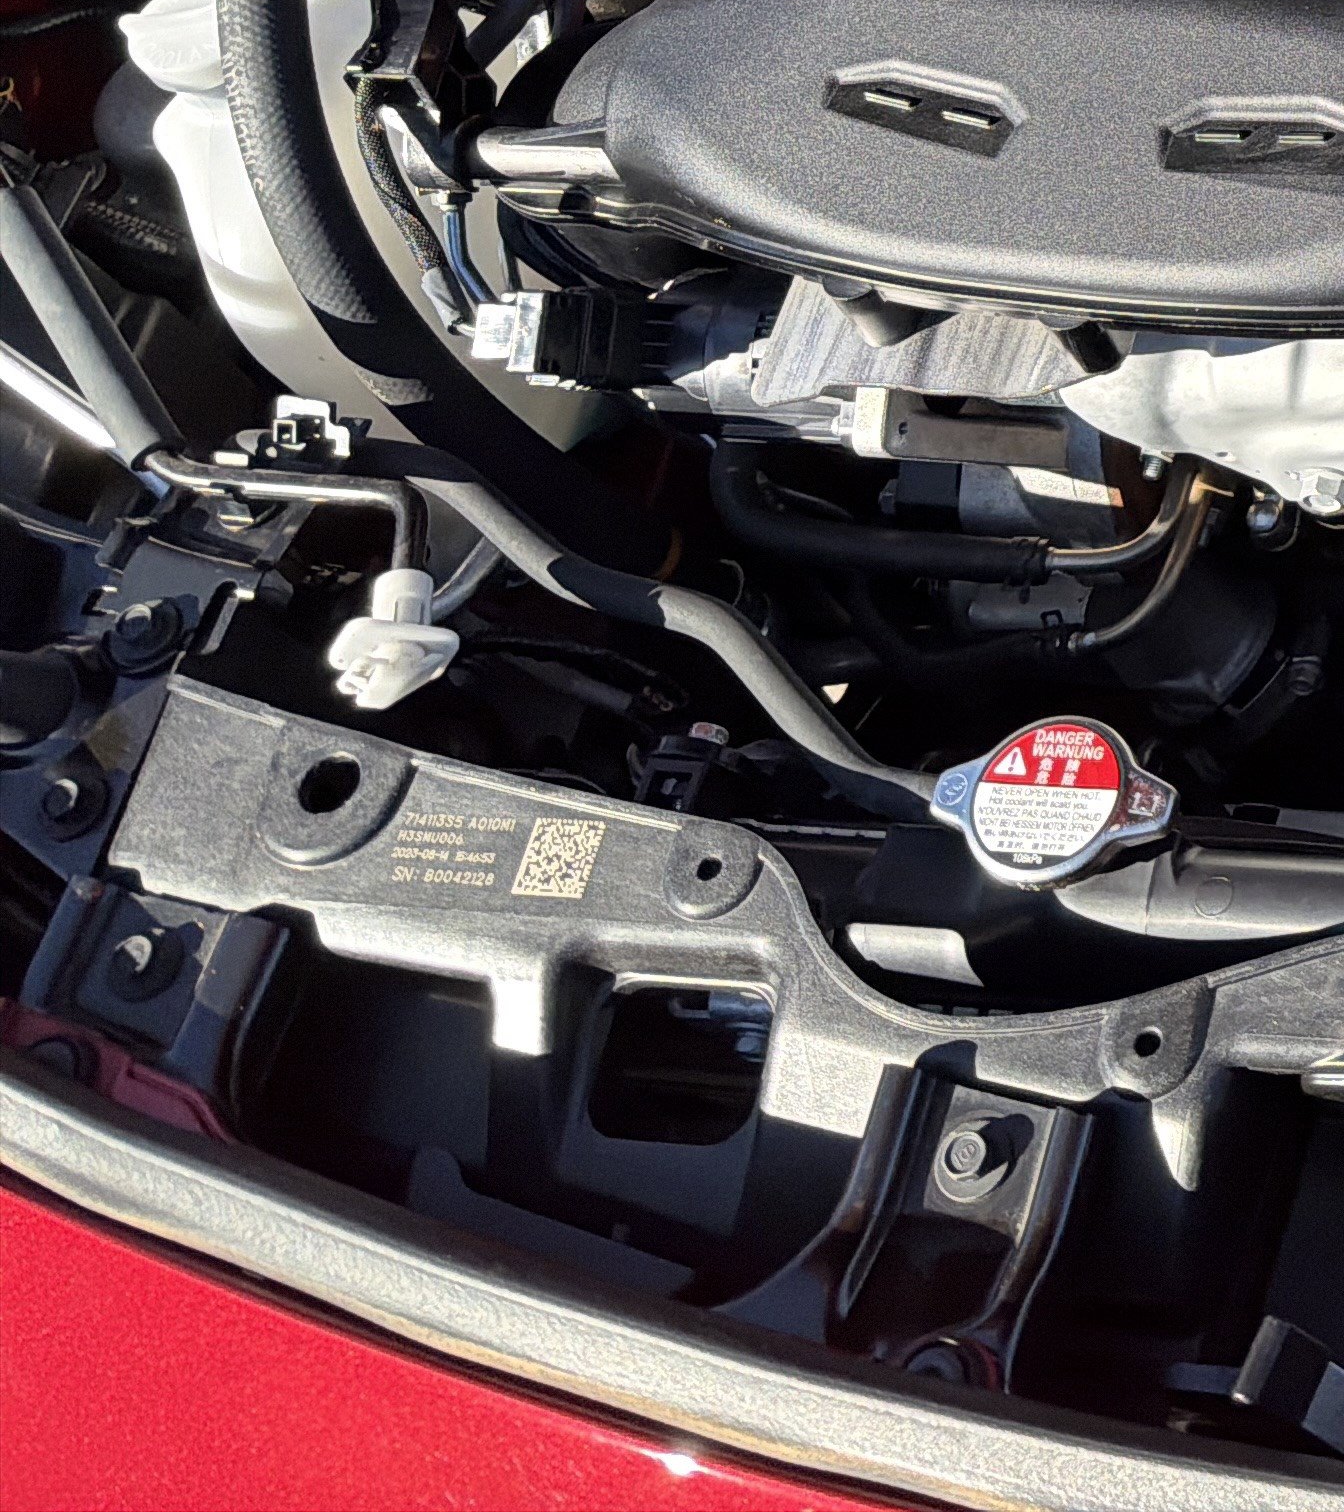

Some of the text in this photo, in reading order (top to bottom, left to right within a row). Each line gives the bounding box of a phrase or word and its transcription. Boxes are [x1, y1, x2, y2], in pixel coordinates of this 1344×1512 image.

[1035, 730, 1094, 745] DANGER
[1032, 743, 1105, 760] WARNUNG
[992, 787, 1022, 796] NEVER
[1024, 788, 1050, 797] OPEN
[1051, 789, 1079, 799] WHEN
[989, 797, 1004, 805] Hot
[1005, 798, 1033, 807] coolant
[1035, 799, 1048, 807] will
[1049, 800, 1072, 809] scald
[1021, 809, 1039, 818] PAS
[1040, 810, 1071, 820] QUAND
[1000, 819, 1012, 827] BEI
[1042, 821, 1068, 831] MOTOR
[390, 846, 450, 862] 2023-08-14
[391, 865, 421, 883] SN:
